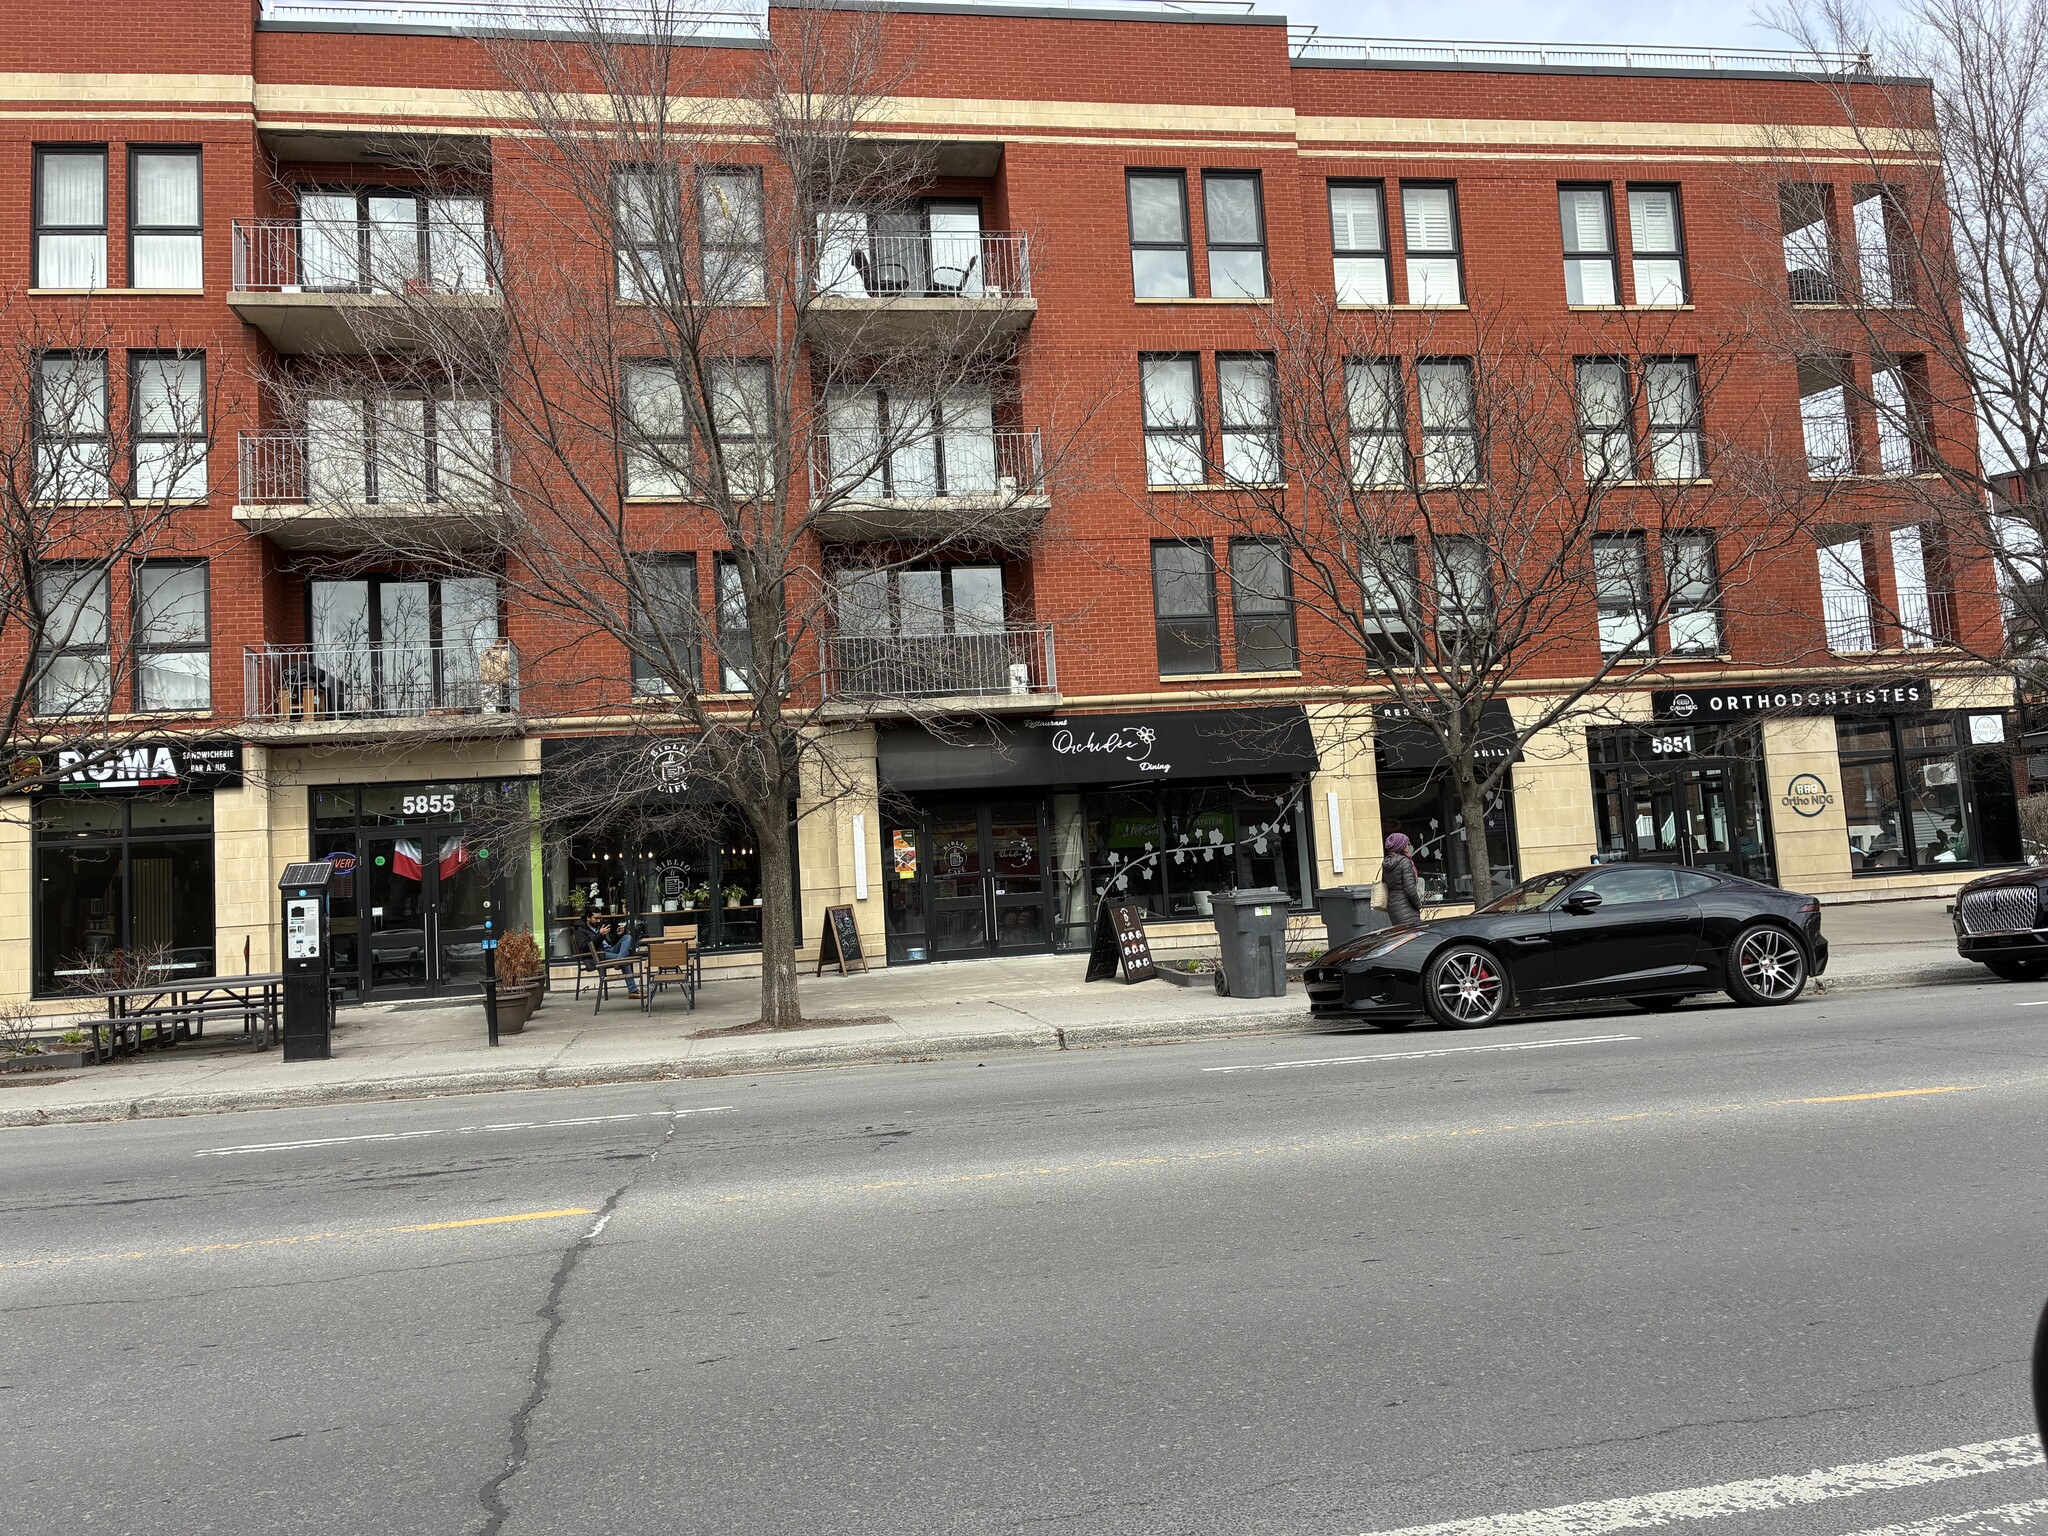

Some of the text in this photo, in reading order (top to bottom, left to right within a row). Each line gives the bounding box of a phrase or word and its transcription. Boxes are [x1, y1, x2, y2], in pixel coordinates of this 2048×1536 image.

[1710, 688, 1919, 711] ORTHODONTISTES
[1023, 719, 1068, 728] Restaurant
[1052, 729, 1138, 754] Orchidée
[1652, 735, 1692, 754] 5851
[182, 750, 234, 760] SANDWICHERIE
[650, 744, 690, 758] BIBLI
[58, 747, 179, 782] ROMA
[190, 764, 204, 773] BAR
[1139, 762, 1171, 773] Dining
[402, 794, 455, 815] 5855
[1781, 795, 1834, 806] Ortho NDG
[323, 858, 356, 868] VERT
[655, 859, 691, 873] BIBLIO
